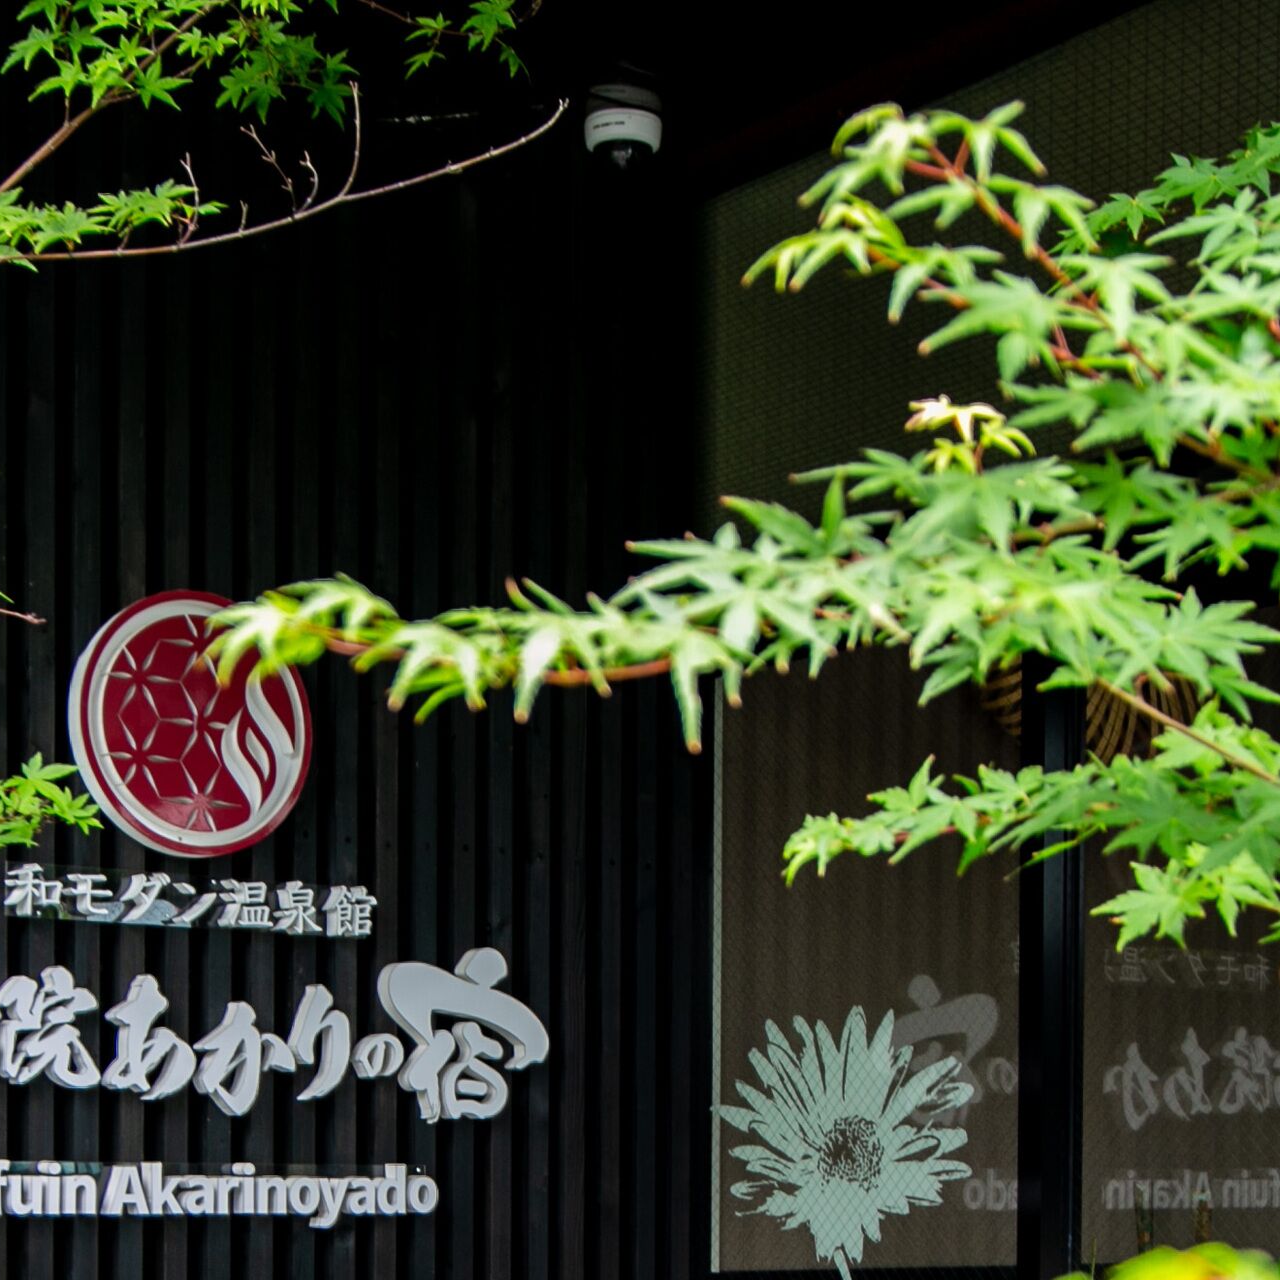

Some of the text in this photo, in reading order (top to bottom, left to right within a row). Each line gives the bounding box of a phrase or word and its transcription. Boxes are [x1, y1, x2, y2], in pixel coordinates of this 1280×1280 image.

[4, 862, 377, 937] 和モダン温泉館
[100, 1161, 439, 1229] Akarinoyado
